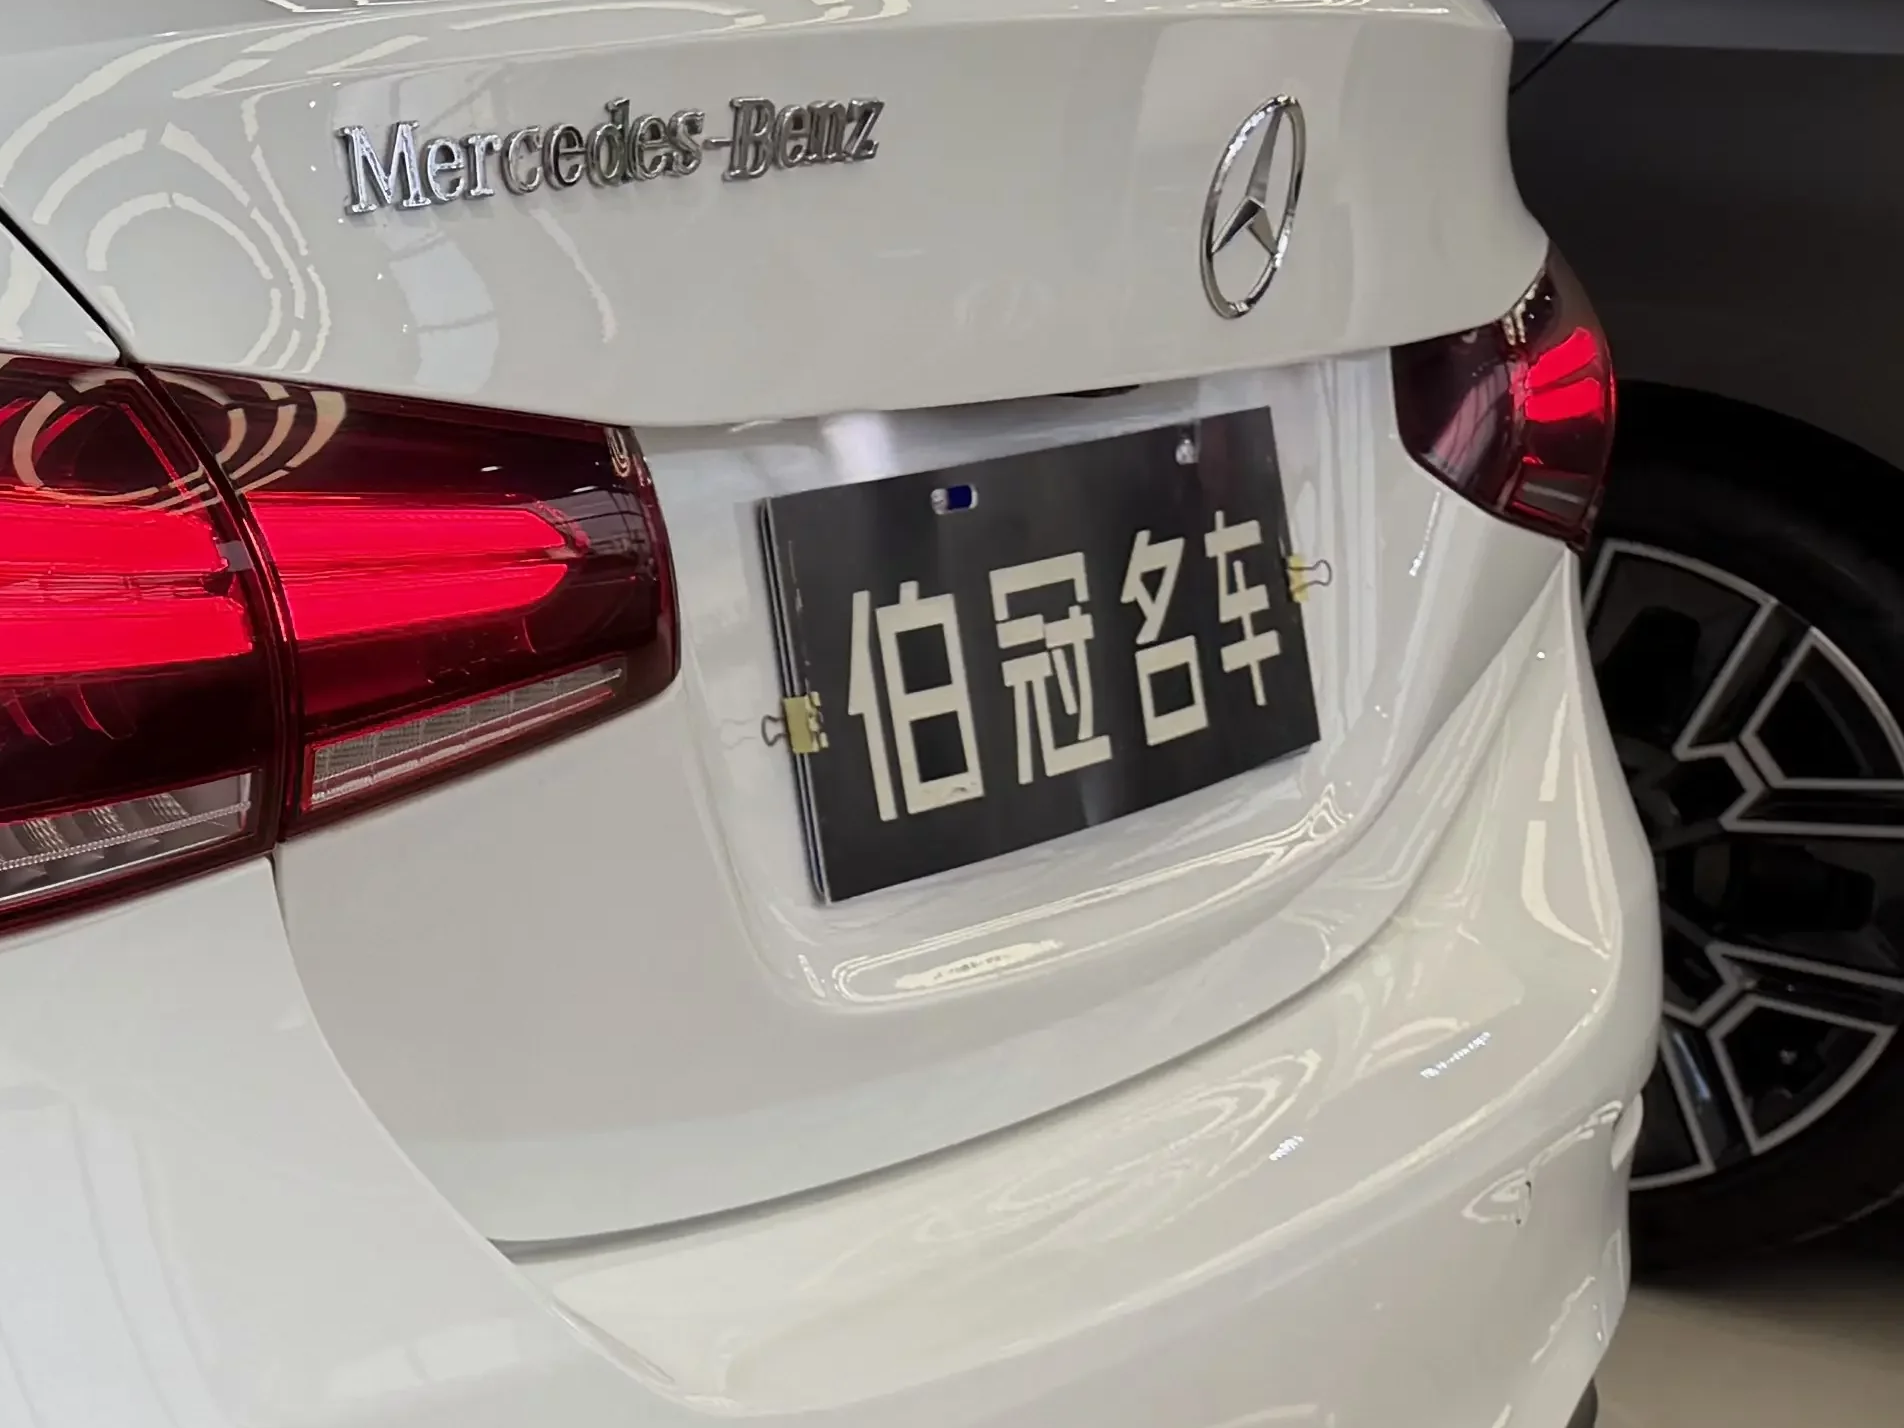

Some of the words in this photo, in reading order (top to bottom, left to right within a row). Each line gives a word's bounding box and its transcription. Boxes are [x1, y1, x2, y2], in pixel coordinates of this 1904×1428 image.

[336, 95, 887, 215] Mercedes-Benz
[847, 509, 1282, 822] 伯冠名车
